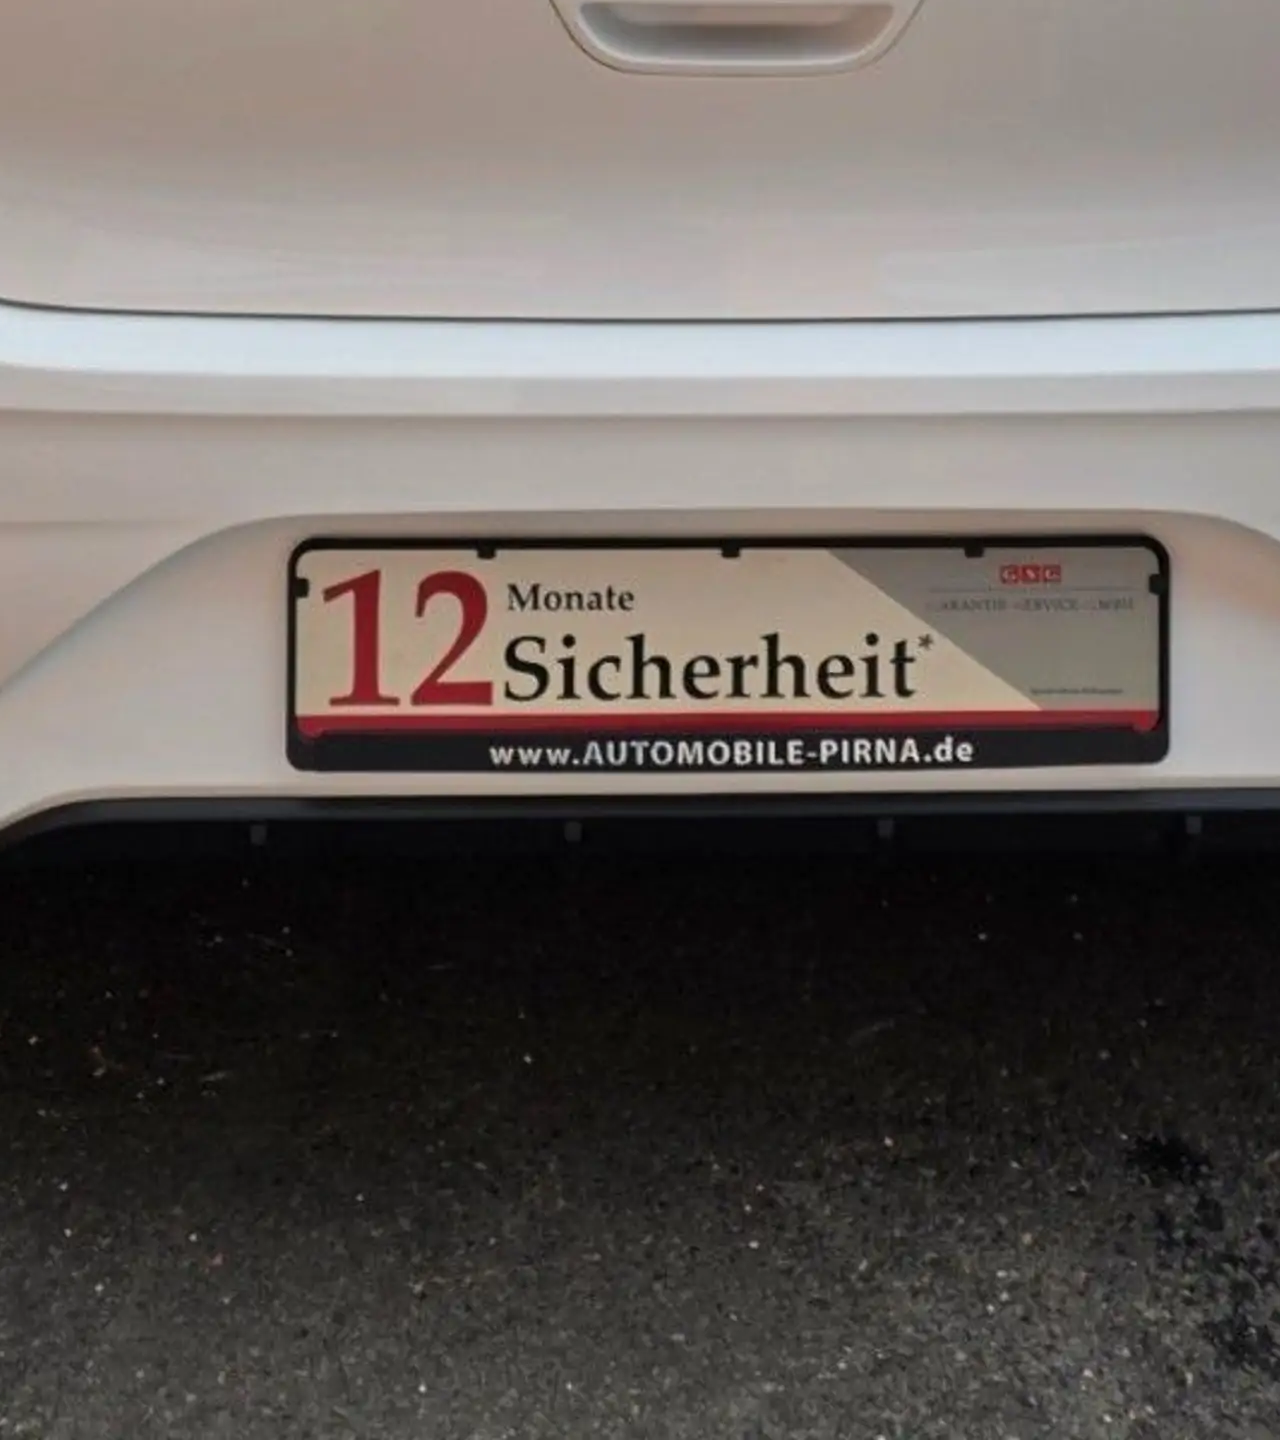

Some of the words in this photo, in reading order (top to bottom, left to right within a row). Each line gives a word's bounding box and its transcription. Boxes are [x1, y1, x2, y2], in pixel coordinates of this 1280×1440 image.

[506, 582, 635, 612] Monate
[322, 569, 493, 707] 12
[489, 736, 975, 767] www.AUTOMOBILE-PIRNA.de
